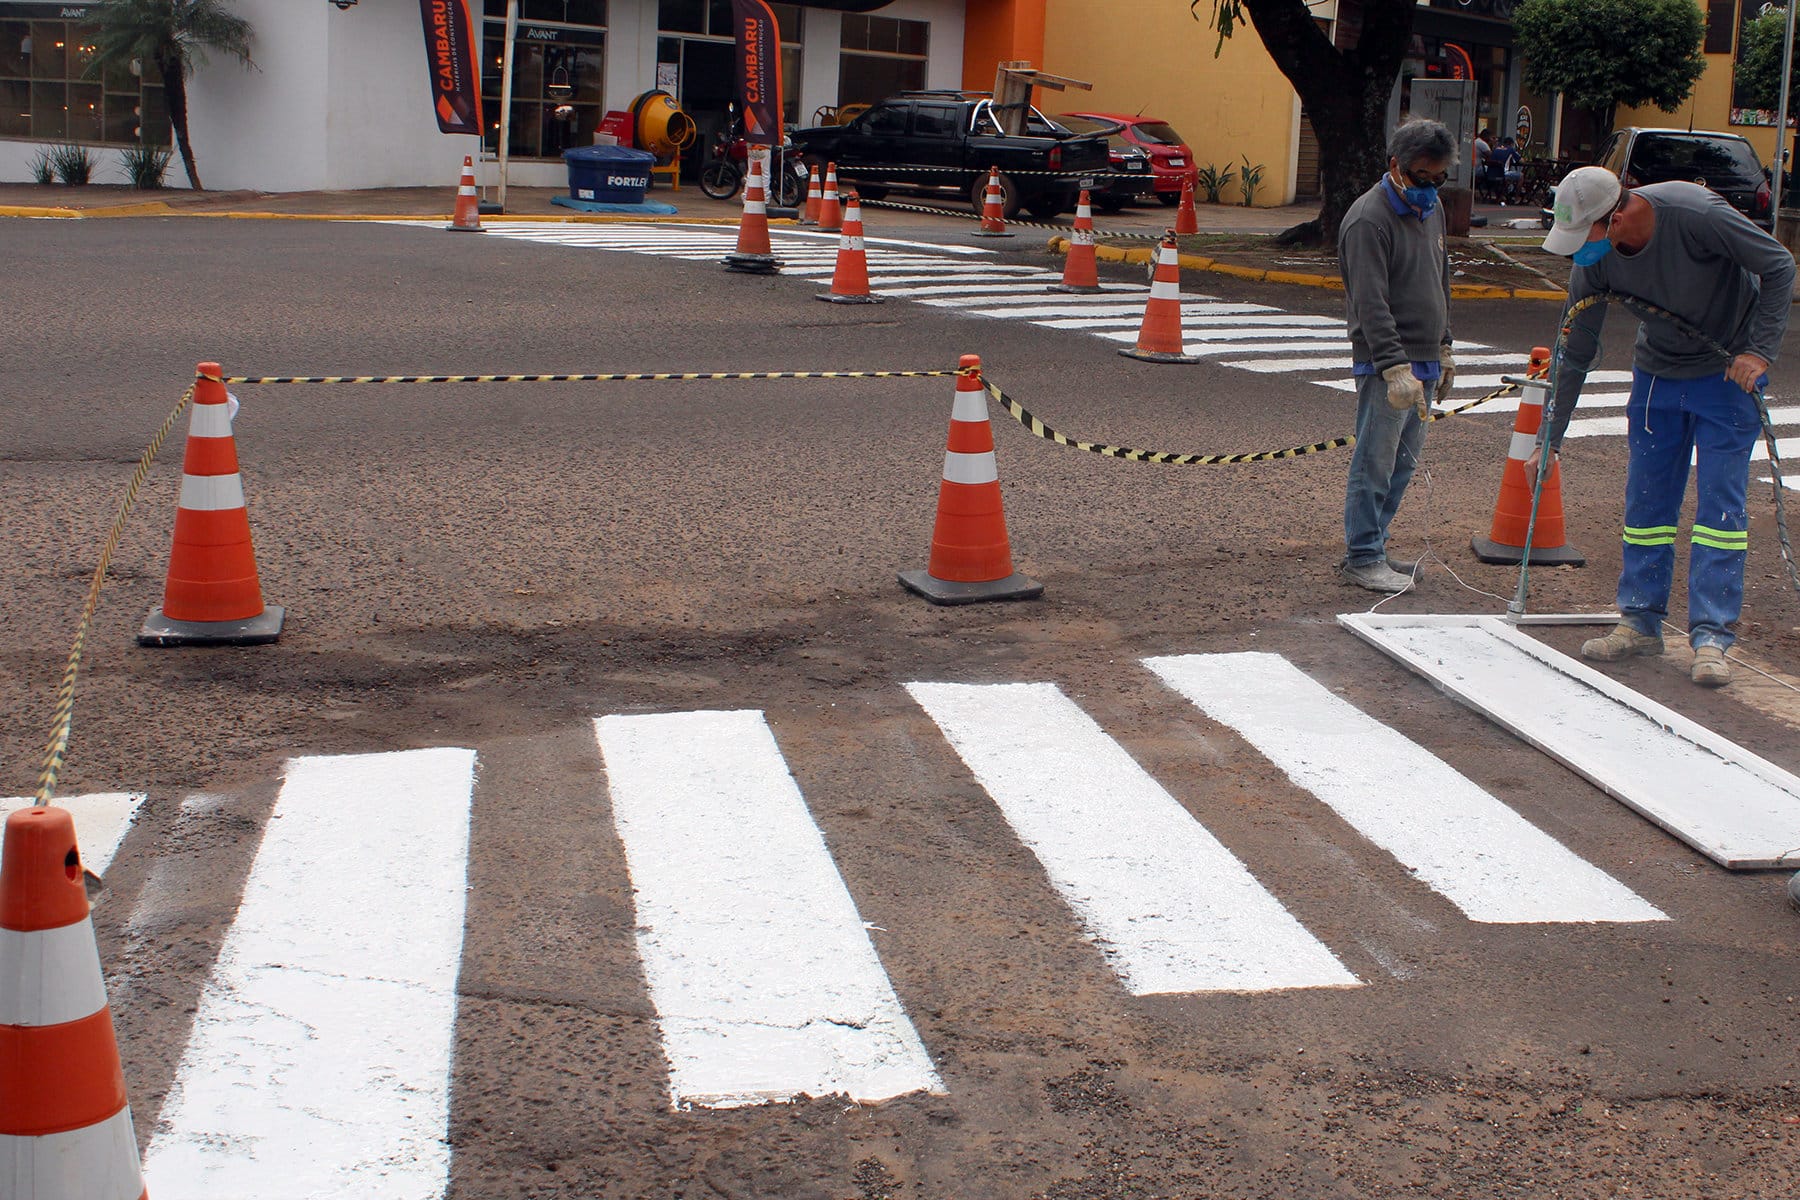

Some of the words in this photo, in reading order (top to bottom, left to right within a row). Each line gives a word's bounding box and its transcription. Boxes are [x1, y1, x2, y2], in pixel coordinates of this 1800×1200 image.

[60, 7, 86, 18] AVANT
[527, 28, 558, 40] AVANT
[432, 0, 454, 91] CAMBARU
[451, 47, 457, 55] DE
[745, 17, 759, 103] CAMBARU
